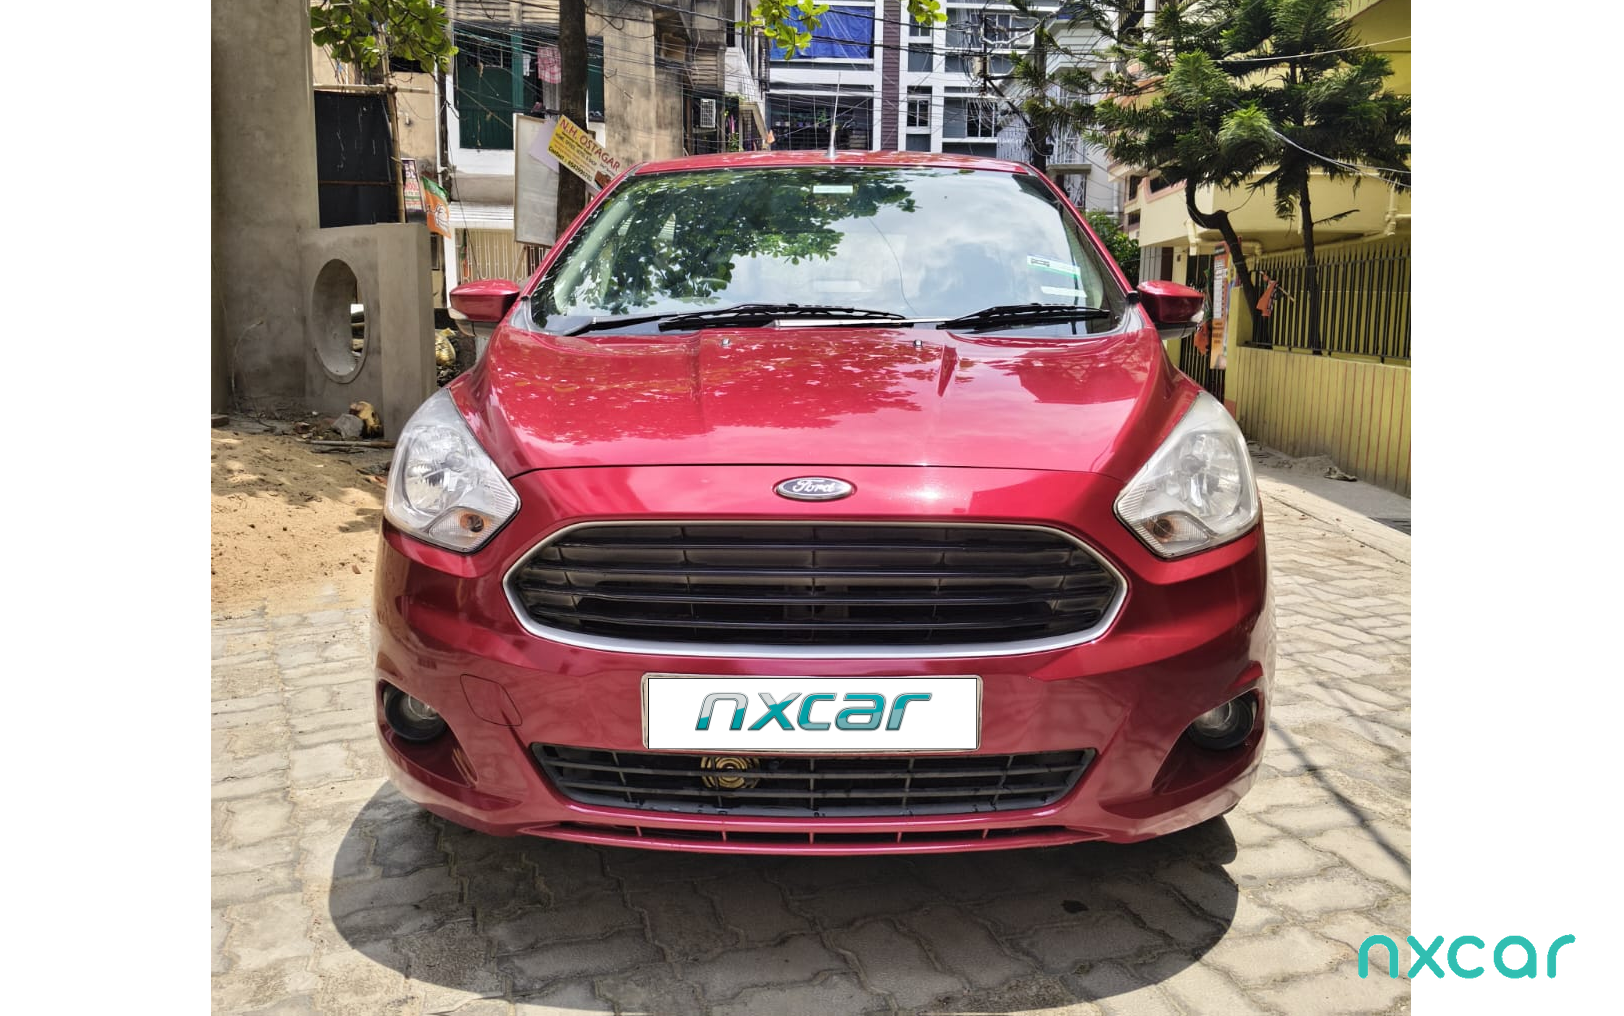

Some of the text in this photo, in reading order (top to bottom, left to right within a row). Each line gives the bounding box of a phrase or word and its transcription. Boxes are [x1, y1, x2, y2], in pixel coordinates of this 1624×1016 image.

[560, 119, 577, 139] N.H.
[579, 134, 620, 171] OSTAGAR
[792, 480, 836, 492] Ford
